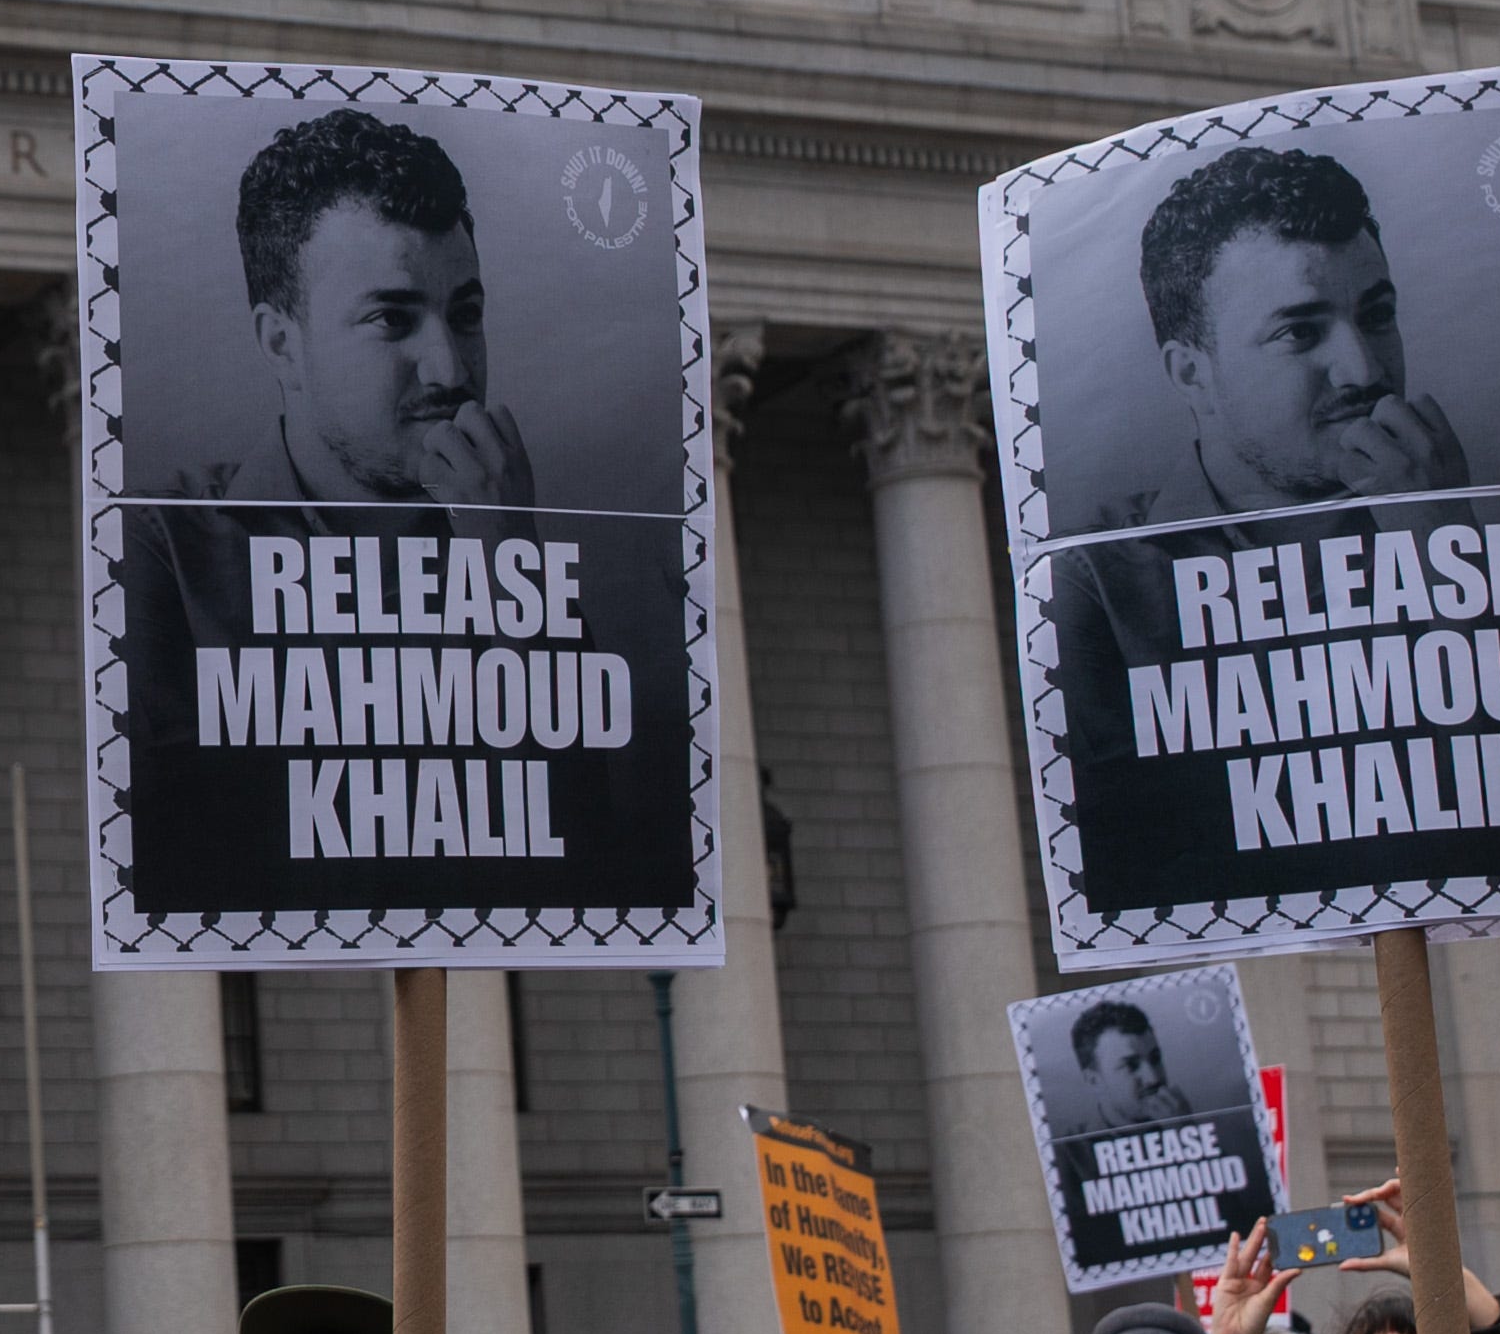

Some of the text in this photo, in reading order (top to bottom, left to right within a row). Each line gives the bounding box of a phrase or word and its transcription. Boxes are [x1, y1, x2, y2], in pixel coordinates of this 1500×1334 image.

[561, 146, 648, 193] SHUT IT DOWN!
[564, 196, 648, 249] FOR PALESTINE
[249, 535, 582, 639] RELEASE
[195, 646, 632, 748] MAHMOUD
[286, 758, 565, 859] KHALIL
[1093, 1121, 1222, 1176] RELEASE
[765, 1154, 786, 1187] In
[792, 1161, 828, 1197] the
[1081, 1157, 1247, 1219] MAHMOUD
[770, 1200, 790, 1230] of
[1119, 1198, 1228, 1247] KHALIL
[781, 1243, 818, 1280] We
[799, 1291, 823, 1324] to
